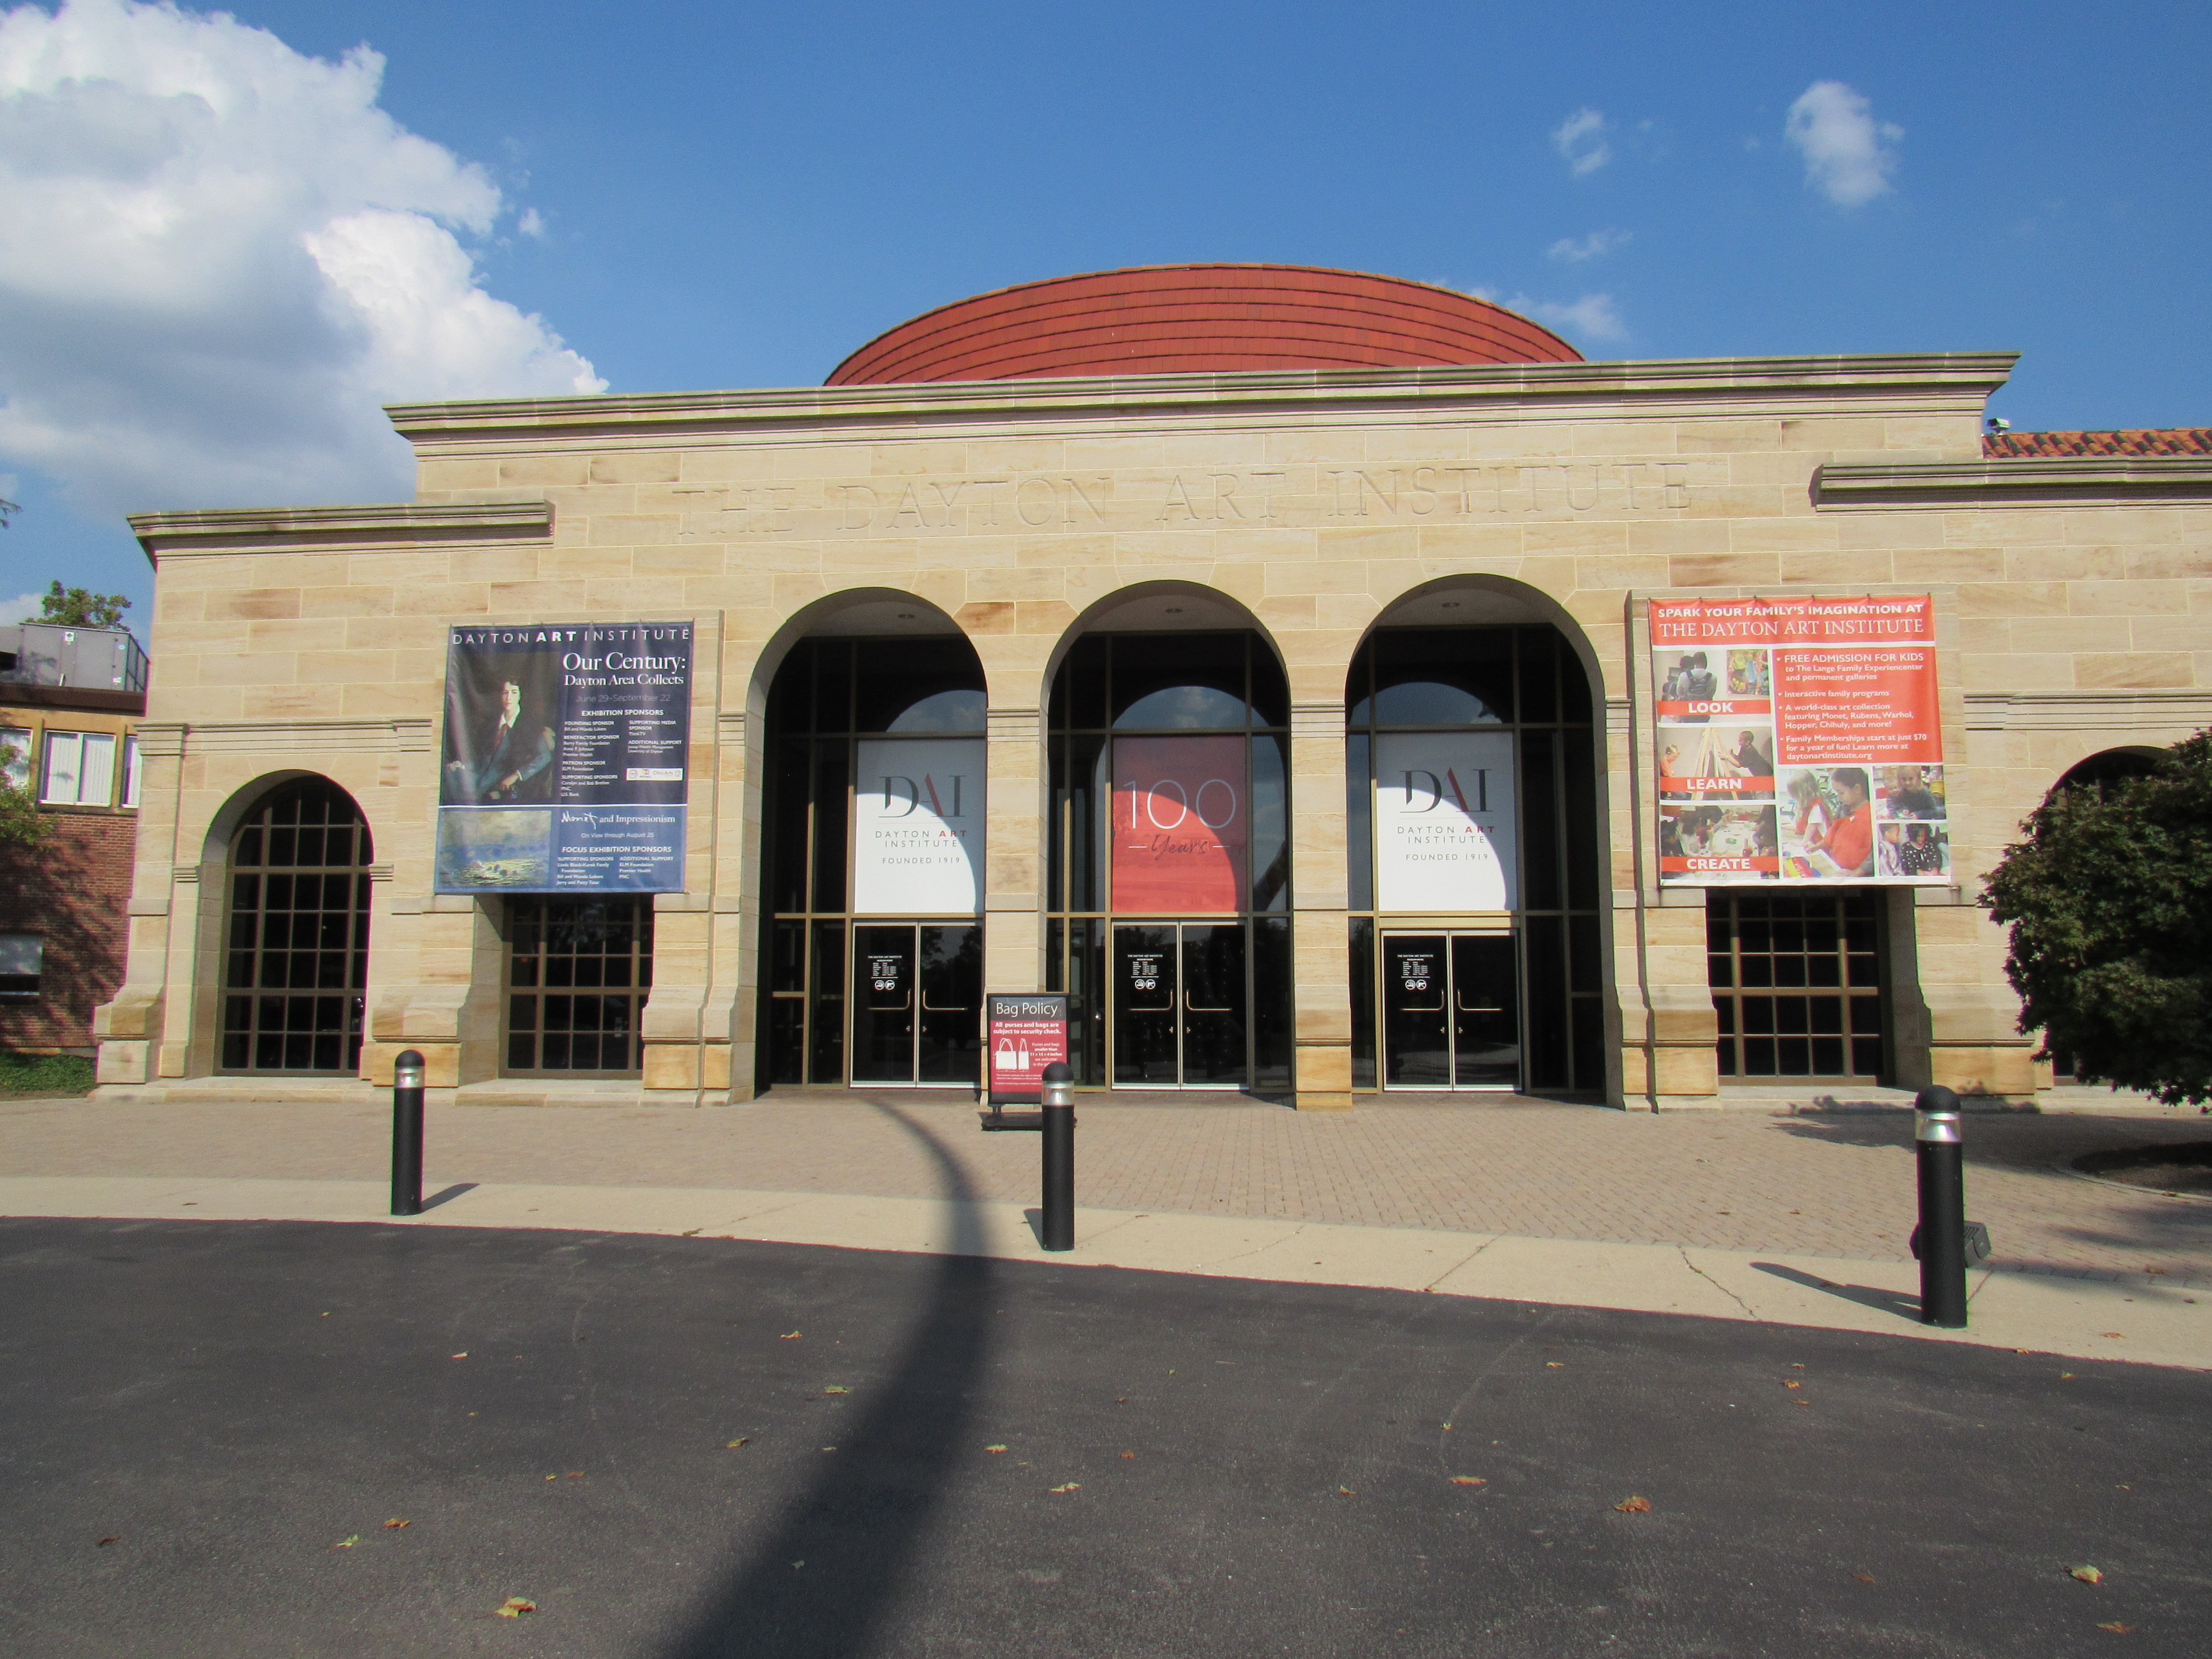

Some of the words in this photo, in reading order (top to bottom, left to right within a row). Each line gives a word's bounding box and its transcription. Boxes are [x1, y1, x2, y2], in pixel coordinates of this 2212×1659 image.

[672, 488, 795, 534] THE
[836, 477, 1110, 531] DAYTON
[1154, 472, 1286, 521] ART
[1327, 462, 1691, 517] INSTITUTE
[1658, 608, 1700, 618] SPARK
[1704, 607, 1742, 617] YOUR
[1746, 605, 1804, 616] FAMILY'S
[1808, 604, 1901, 615] IMAGINATION
[1905, 603, 1923, 613] AT
[1659, 623, 1697, 637] THE
[1701, 621, 1778, 637] DAYTON
[1784, 620, 1819, 636] ART
[1824, 618, 1924, 635] INSTITUTE
[453, 632, 529, 645] DAYTON
[536, 631, 577, 643] ART
[584, 628, 690, 641] INSTITUTE
[563, 652, 602, 671] Our
[606, 651, 686, 674] Century:
[1784, 654, 1810, 663] FREE
[1812, 653, 1872, 662] ADMISSION
[1874, 653, 1897, 662] FOR
[1899, 652, 1924, 661] KIDS
[1813, 664, 1836, 673] Lange
[1837, 664, 1863, 673] Family
[565, 674, 607, 688] Dayton
[609, 675, 635, 685] Area
[637, 673, 684, 685] Collects
[1845, 674, 1877, 682] galleries
[576, 694, 596, 703] June
[599, 694, 659, 704] 29-September
[660, 694, 672, 702] 22
[1827, 690, 1850, 698] family
[1688, 702, 1734, 713] LOOK
[1786, 735, 1811, 744] Family
[1787, 752, 1873, 761] daytonartinstitute.org
[1399, 768, 1493, 813] DAI
[1686, 778, 1743, 790] LEARN
[878, 773, 966, 818] DAI
[1123, 779, 1236, 830] 100
[562, 810, 598, 830] Monet
[616, 815, 675, 825] Impressionism
[1151, 834, 1208, 861] Years
[1686, 858, 1751, 870] CREATE
[996, 1002, 1018, 1018] Bag
[1022, 1002, 1058, 1018] Policy
